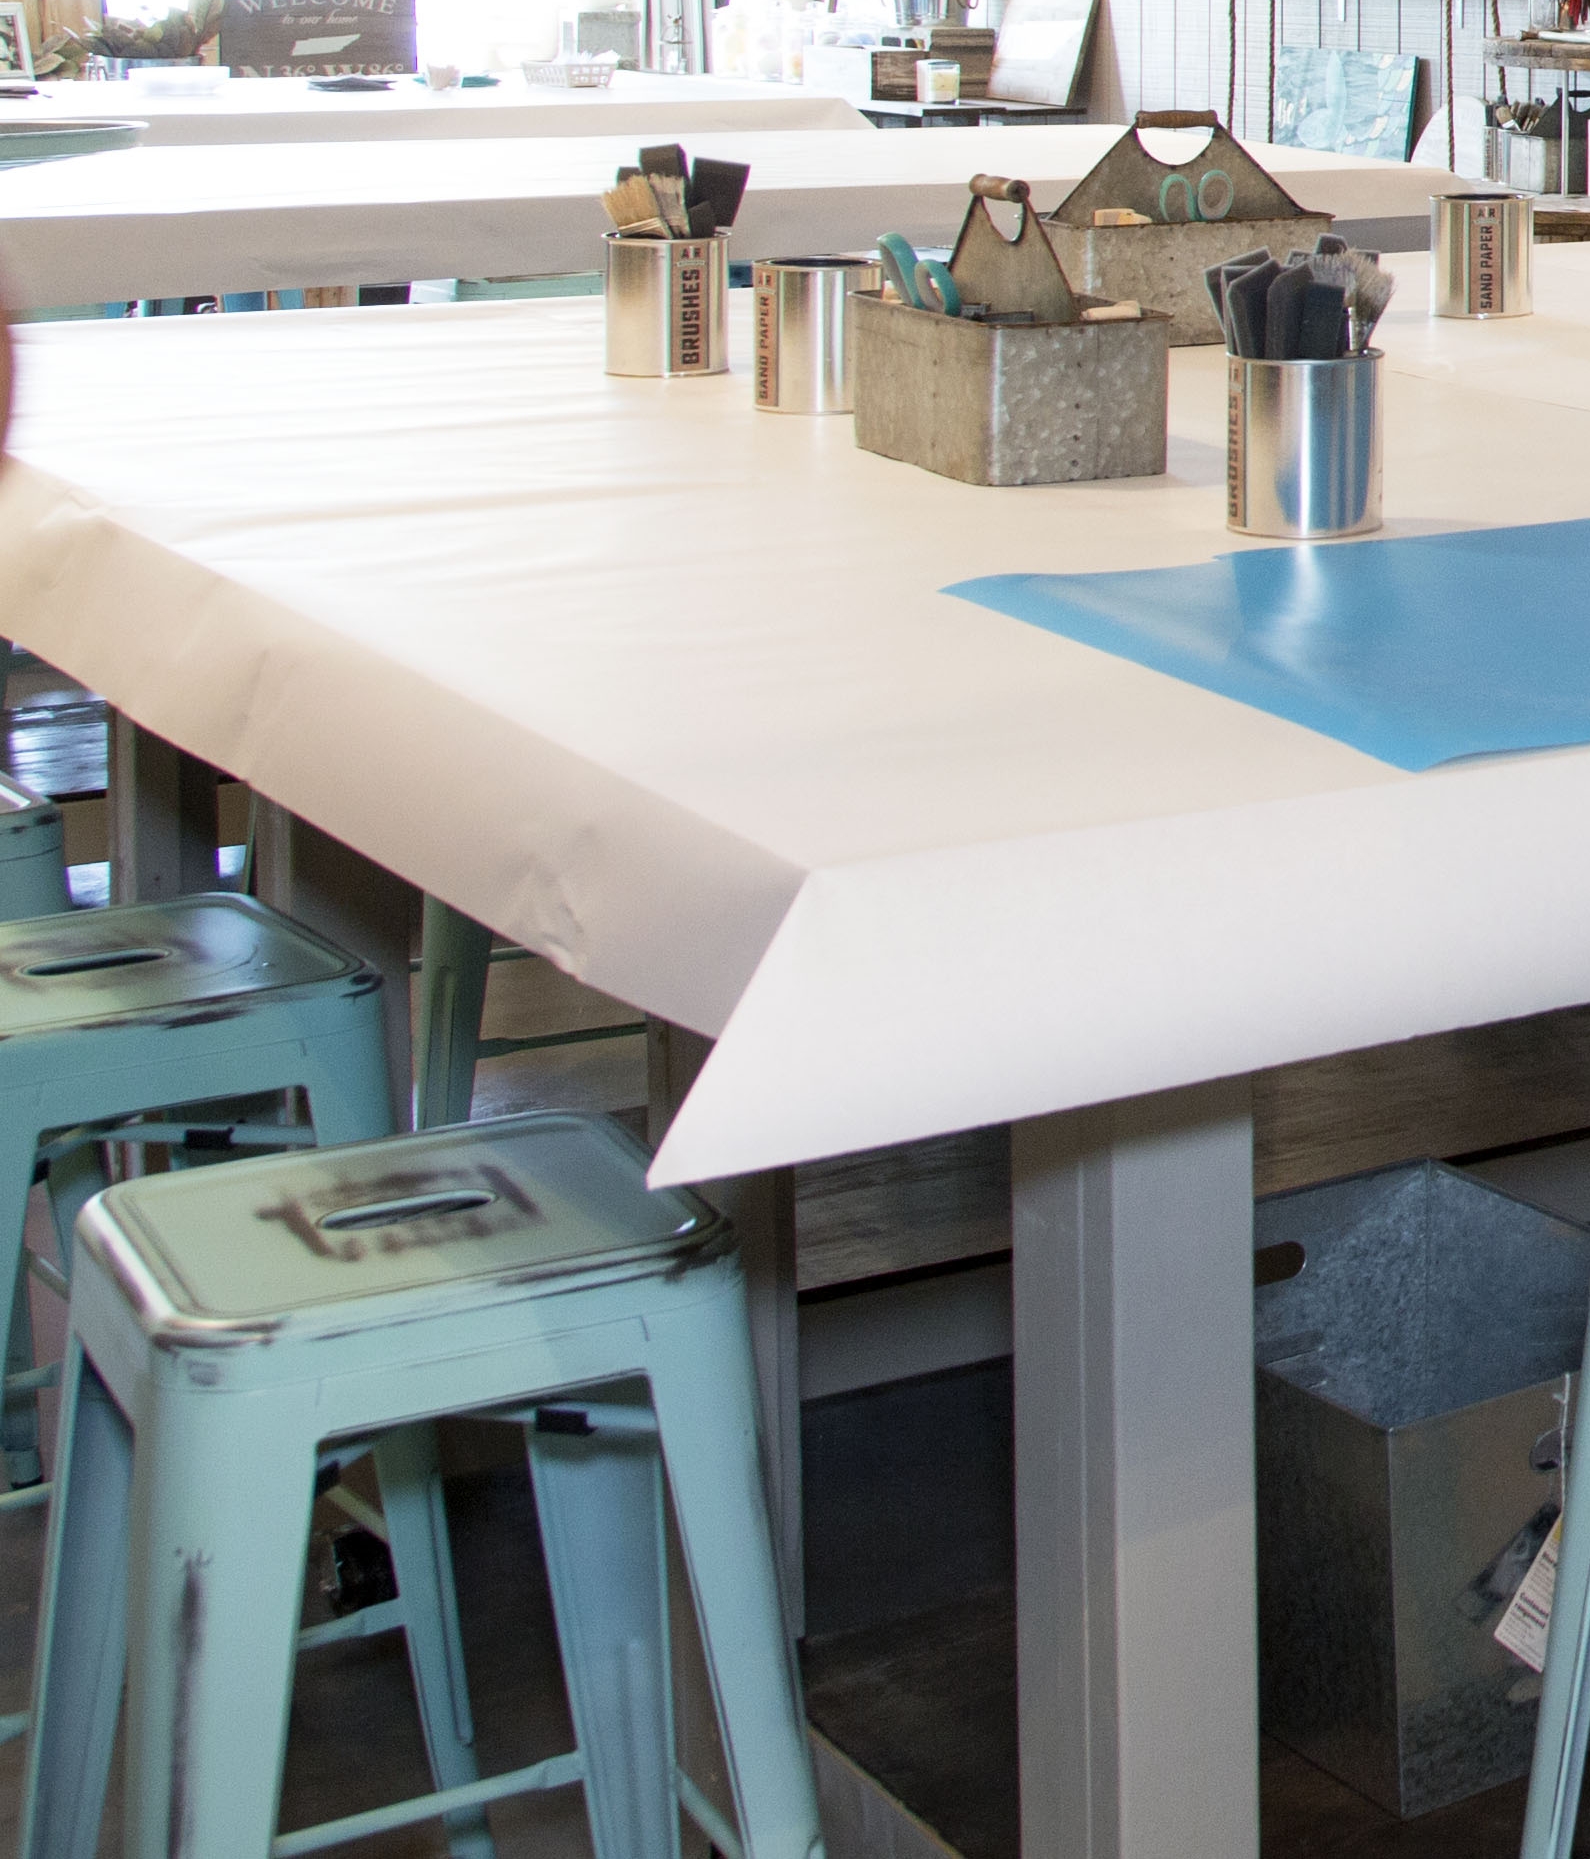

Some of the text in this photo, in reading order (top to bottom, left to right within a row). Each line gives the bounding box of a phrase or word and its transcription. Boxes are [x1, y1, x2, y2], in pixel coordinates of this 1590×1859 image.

[281, 8, 359, 25] to our home
[1480, 226, 1494, 309] SAND PAPER
[680, 269, 700, 365] BRUSHES
[759, 295, 770, 400] SAND PAPER
[1228, 395, 1239, 518] BRUSHES
